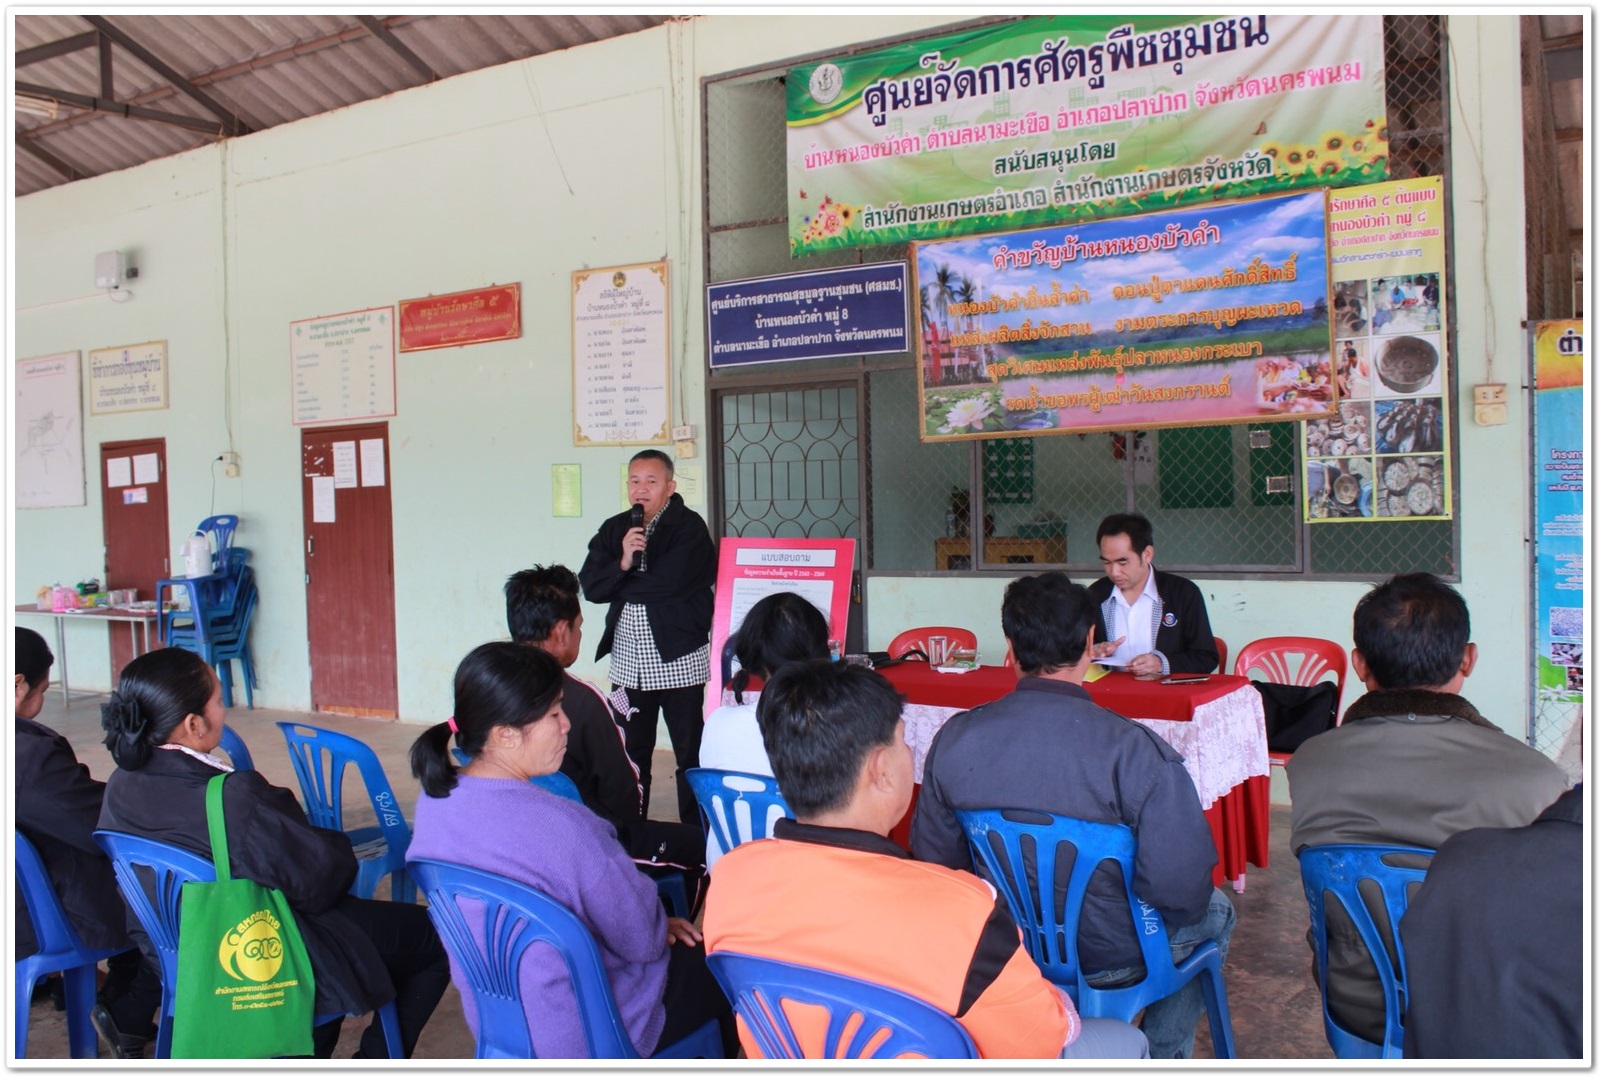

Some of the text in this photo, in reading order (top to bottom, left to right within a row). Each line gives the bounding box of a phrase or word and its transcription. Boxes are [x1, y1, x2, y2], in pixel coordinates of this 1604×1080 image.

[864, 15, 1269, 126] ศูนย์จัดการศัตรูพืชชุมชน
[804, 62, 1361, 169] บ้านหนองบัวคำ ตำบลนามะเขือ อำเภอปลาปาก จังหวัดนครพนม
[994, 141, 1116, 174] สนับสนุนโดย
[864, 152, 1272, 228] สำนักงานเกษตรอำเภอ สำนักงานเกษตรจังหวัด
[1395, 186, 1436, 204] ต้นแบบ
[1396, 206, 1412, 226] หมู่
[993, 219, 1220, 269] คำขวัญบ้านหนองบัวคำ
[1112, 252, 1298, 302] ดอนปู่ตาแดนศักดิ์สิทธิ์
[711, 282, 863, 315] ศูนย์บริการสาธารณสุขมูลฐานชุมชน
[755, 306, 848, 328] บ้านหนองบัวคำ หมู่ 8
[950, 319, 1093, 347] แหล่งผลิตสิ่งจักสาน
[713, 327, 904, 353] ตำบลนามะเขือ อำเภอปลาปาก จังหวัดนครพนม
[761, 553, 811, 562] แบบสอบถาม
